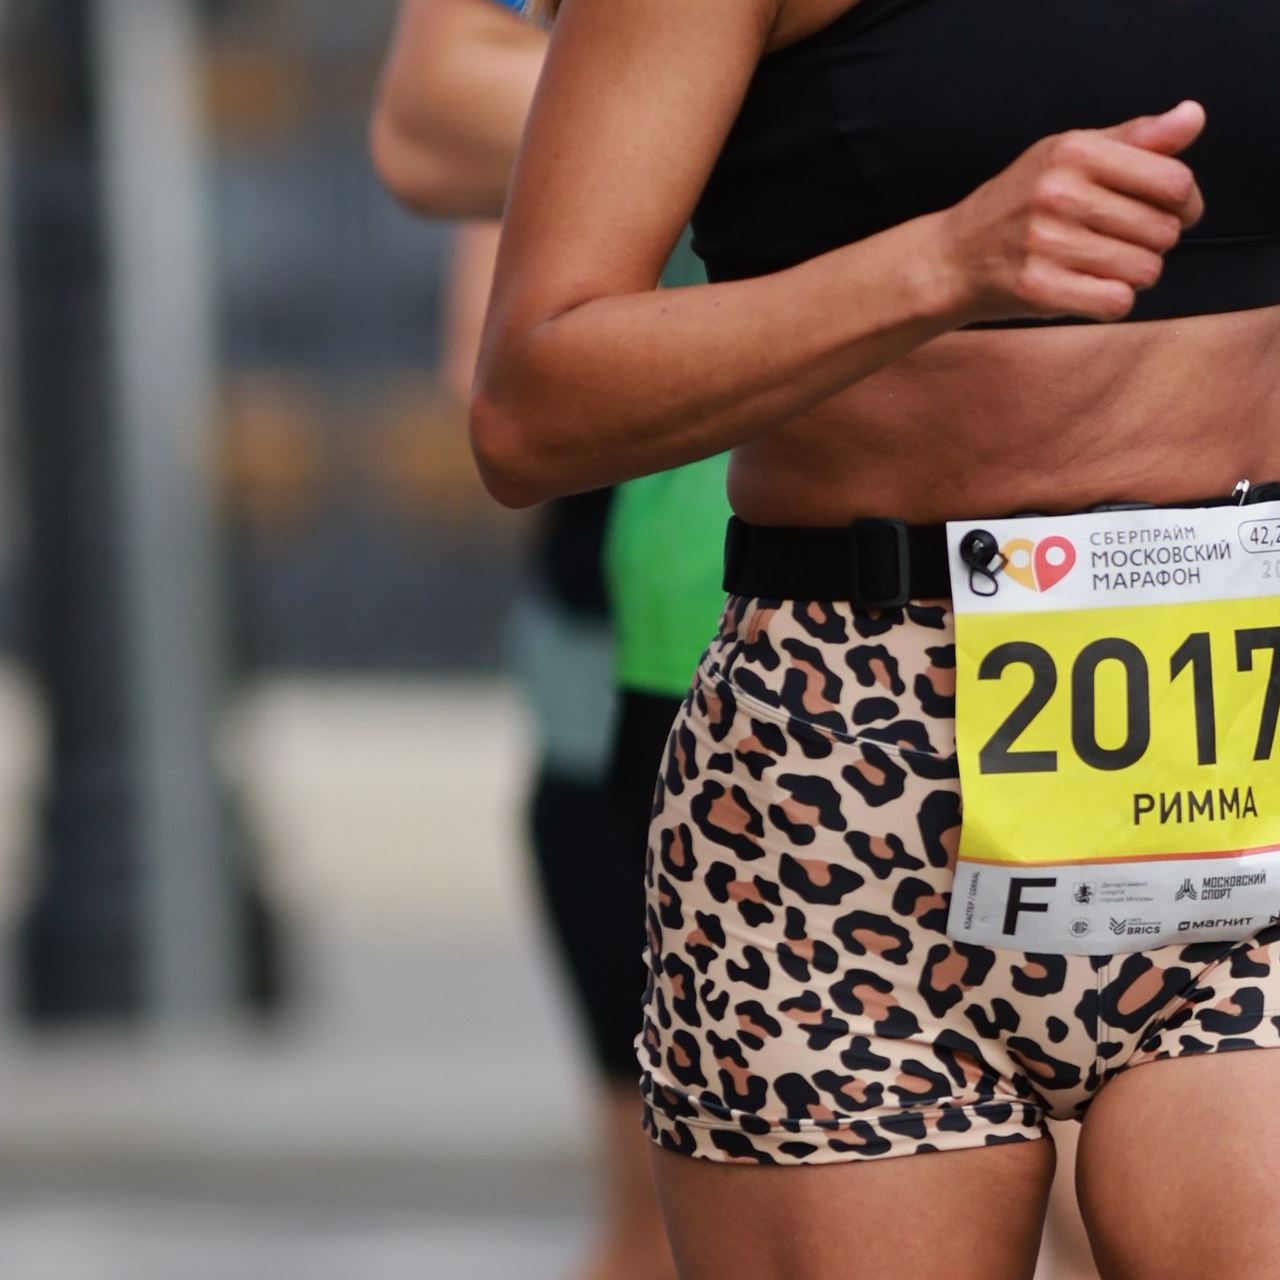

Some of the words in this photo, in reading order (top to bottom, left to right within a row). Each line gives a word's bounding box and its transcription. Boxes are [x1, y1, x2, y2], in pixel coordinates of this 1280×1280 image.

[1090, 525, 1196, 546] СБЕРПРАЙМ
[1091, 539, 1232, 568] МОСКОВСКИЙ
[1092, 567, 1201, 590] МАРАФОН
[1133, 786, 1258, 826] РИММА
[1202, 870, 1266, 888] МОСКОВСКИЙ
[1201, 888, 1232, 900] СПОРТ
[1002, 877, 1057, 936] F
[1127, 926, 1161, 935] BRICS
[1191, 916, 1254, 929] магнит
